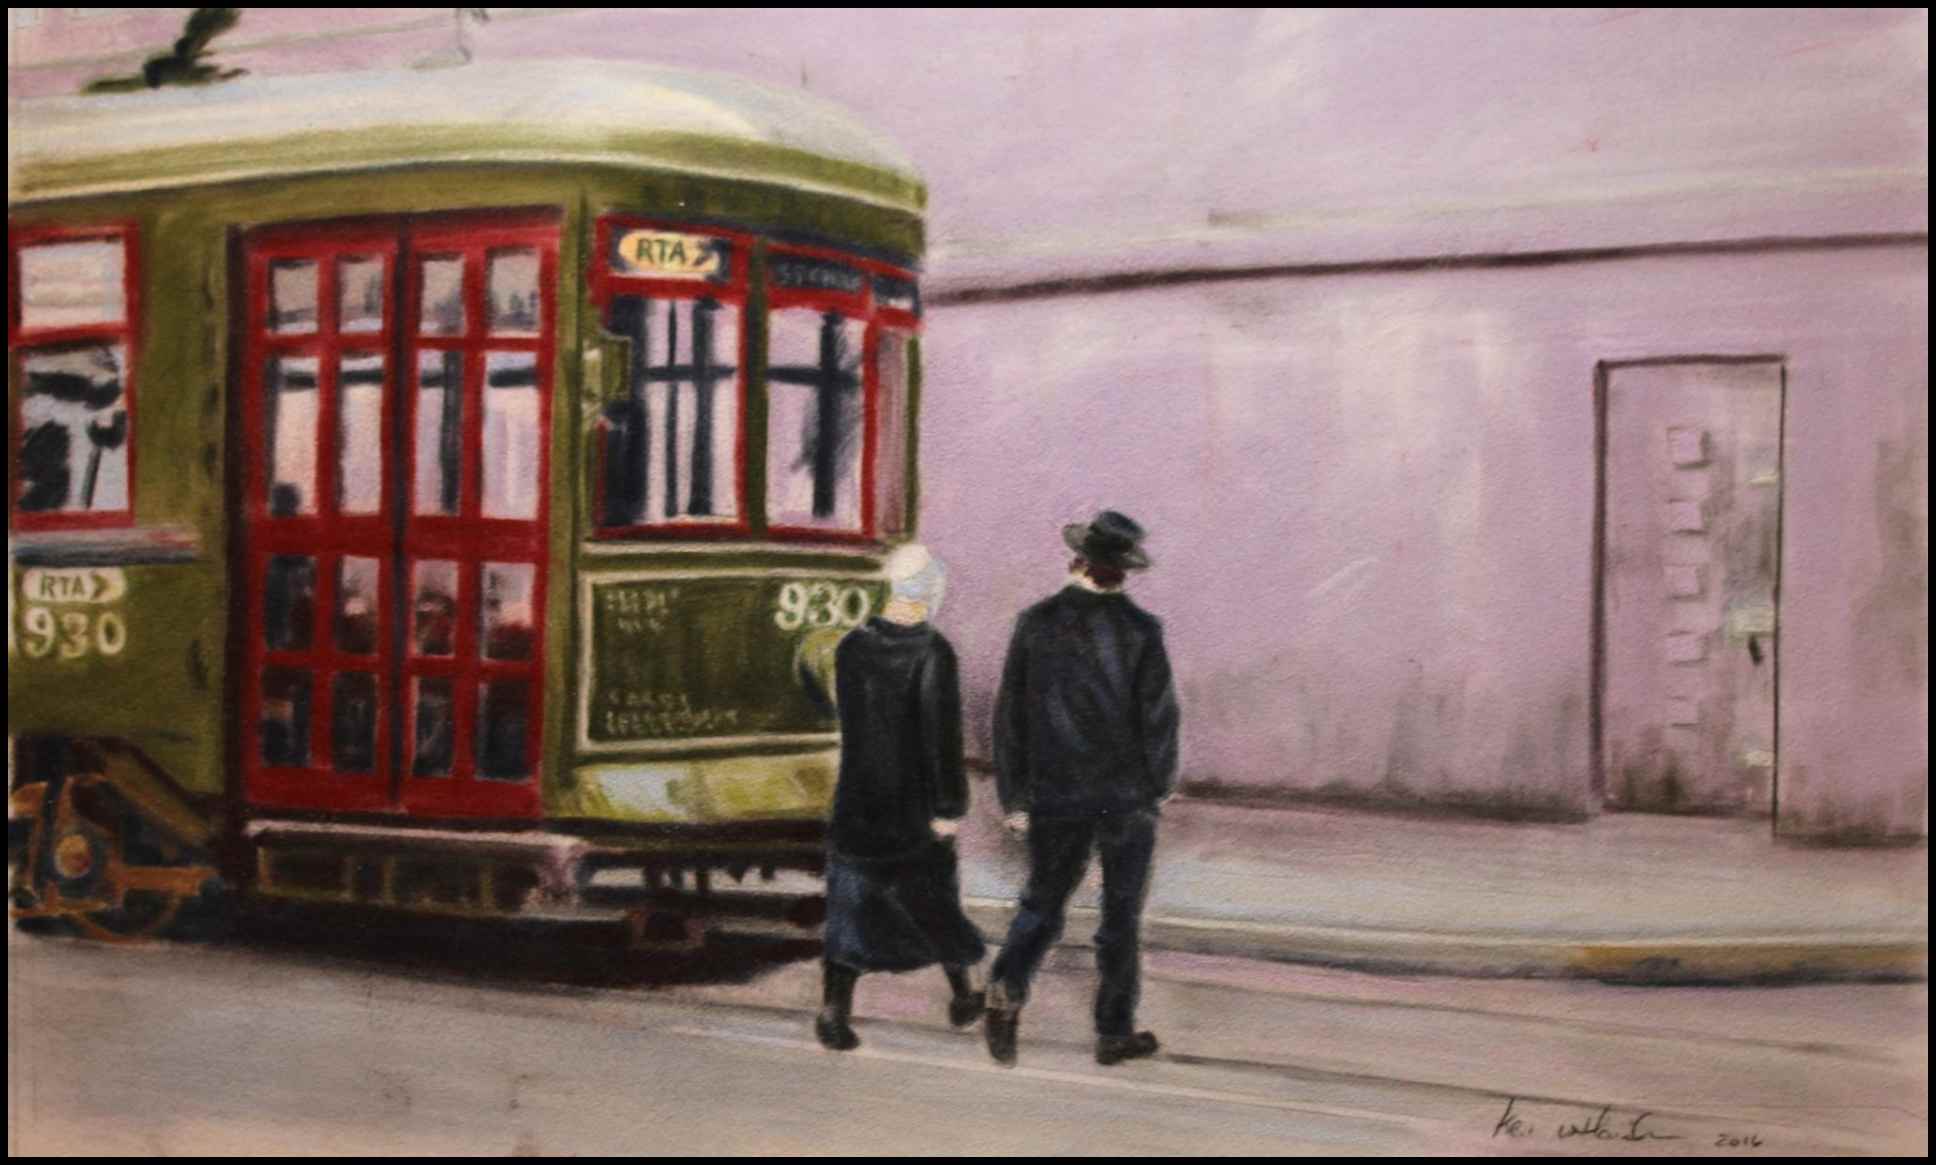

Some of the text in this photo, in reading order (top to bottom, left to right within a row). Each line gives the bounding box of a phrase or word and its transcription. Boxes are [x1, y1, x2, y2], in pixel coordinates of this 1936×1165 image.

[636, 238, 686, 264] RTA
[41, 576, 85, 597] RTA
[774, 582, 870, 631] 930
[23, 607, 126, 659] 930
